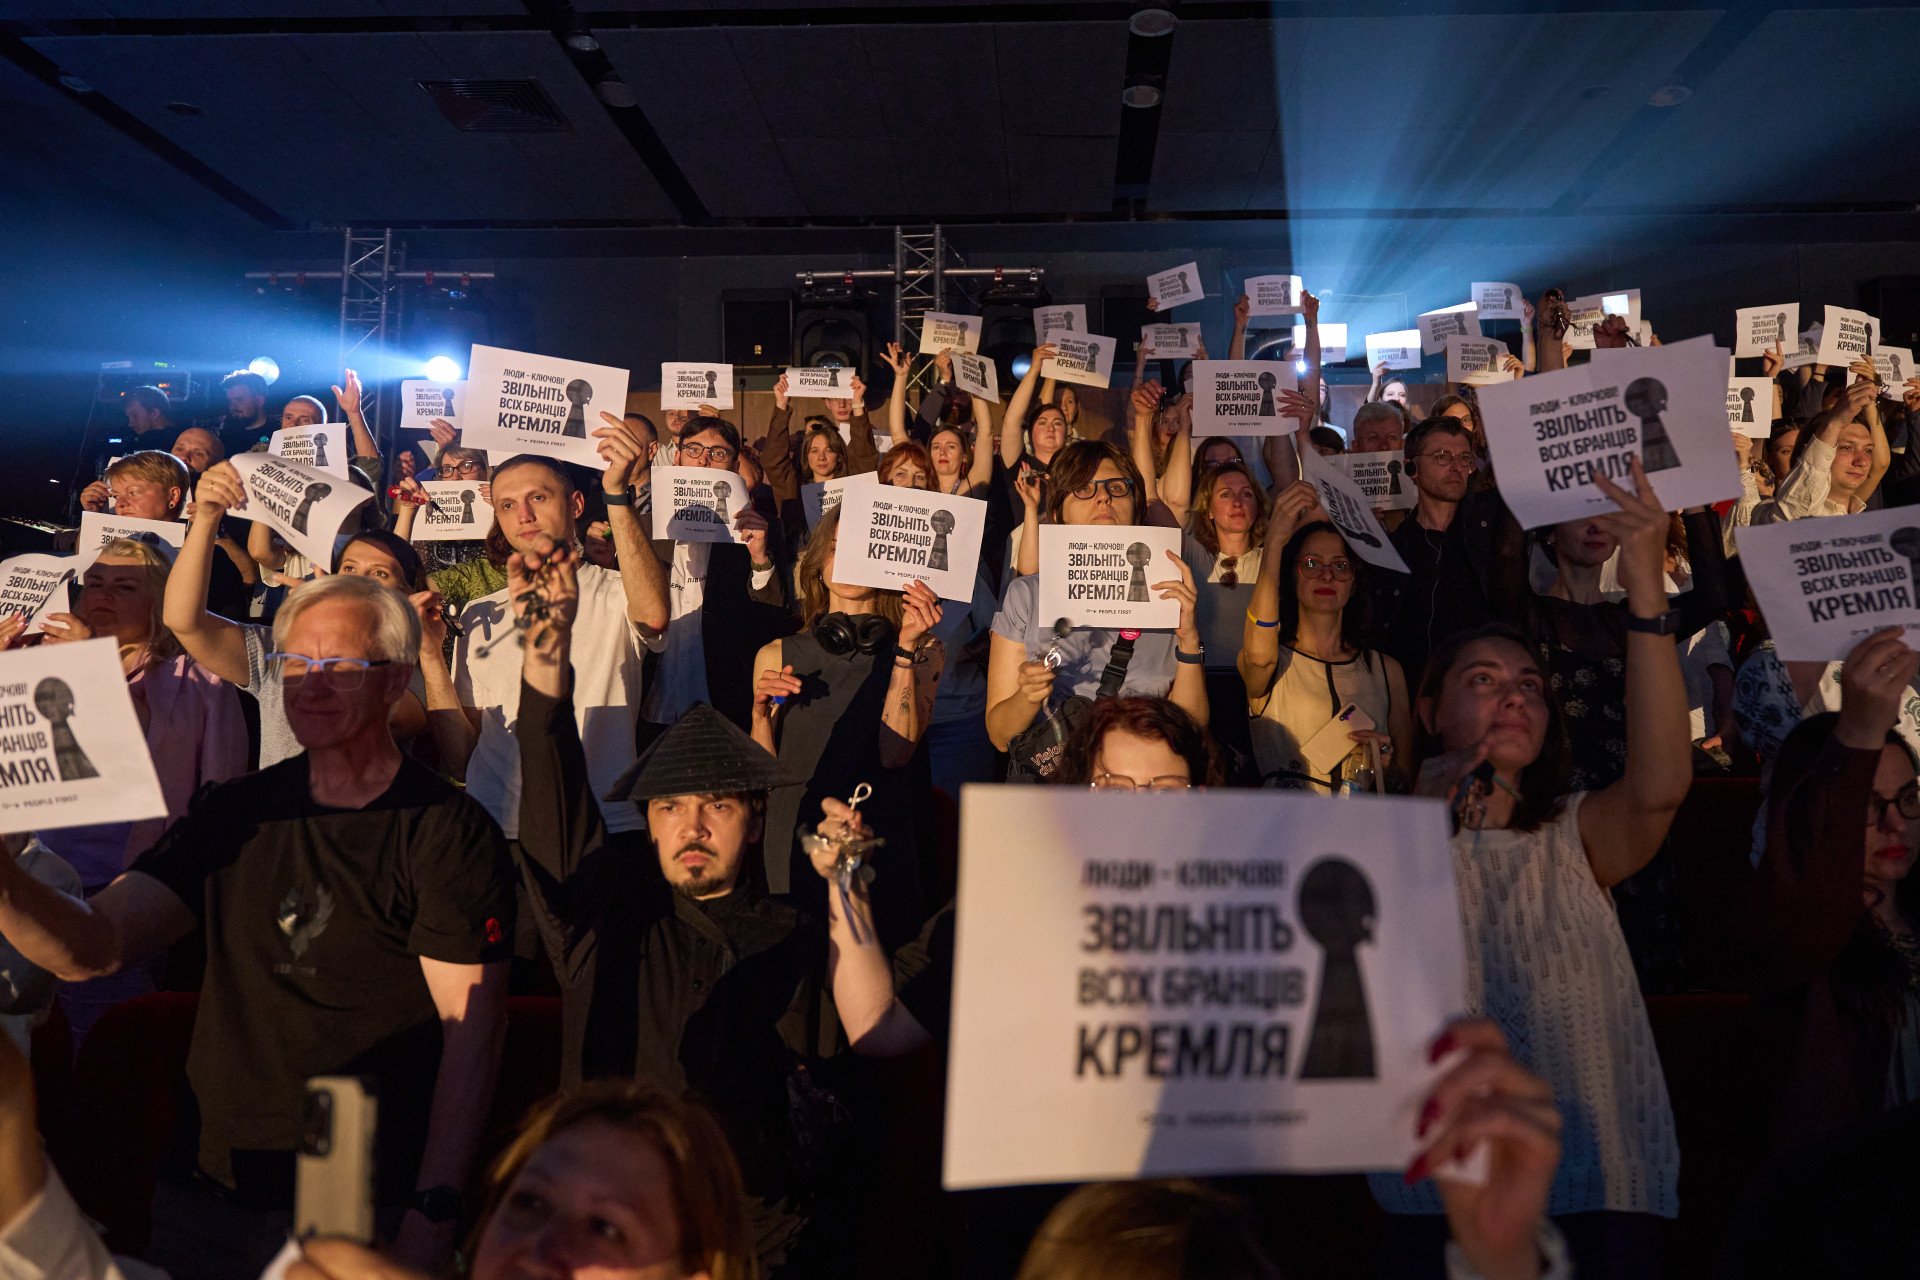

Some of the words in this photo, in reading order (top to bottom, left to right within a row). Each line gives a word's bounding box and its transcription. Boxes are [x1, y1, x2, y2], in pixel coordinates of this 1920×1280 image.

[1574, 328, 1592, 336] КРЕМ
[1840, 323, 1864, 335] ЗВІЛЬНІТЬ
[1752, 335, 1776, 344] КРЕМЛЯ
[1837, 341, 1865, 352] КРЕМЛЯ
[1060, 344, 1087, 354] ЗВІЛЬНІТЬ
[1057, 358, 1085, 370] КРЕМЛЯ
[1461, 363, 1487, 371] КРЕМЛЯ
[503, 369, 524, 378] ЛЮДИ
[532, 373, 565, 385] КЛЮЧОВІ!
[502, 380, 564, 402] ЗВІЛЬНІТЬ
[1216, 381, 1258, 390] ЗВІЛЬНІТЬ
[1216, 393, 1230, 401] ВСІХ
[1232, 393, 1260, 402] БРАНЦІВ
[1530, 399, 1560, 416] ЛЮДИ
[1569, 386, 1619, 406] КЛЮЧОВІ!
[500, 398, 522, 411] ВСІХ
[524, 402, 566, 417] БРАНЦІВ
[1216, 404, 1258, 416] КРЕМЛЯ
[498, 412, 561, 434] КРЕМЛЯ
[1534, 404, 1627, 441] ЗВІЛЬНІТЬ
[282, 440, 313, 449] ЗВІЛЬНІТЬ
[1538, 441, 1572, 463] ВСІХ
[1574, 427, 1638, 455] БРАНЦІВ
[256, 463, 304, 493] ЗВІЛЬНІТЬ
[1354, 468, 1387, 478] ЗВІЛЬНІТЬ
[250, 474, 267, 489] ВСІХ
[266, 481, 298, 507] БРАНЦІВ
[674, 487, 712, 498] ЗВІЛЬНІТЬ
[1361, 486, 1388, 496] РЕМЛЯ
[689, 500, 715, 508] БРАНЦІВ
[873, 501, 892, 510] ЛЮДИ
[899, 505, 930, 515] КЛЮЧОВІ!
[425, 515, 460, 524] КРЕМЛЯ
[674, 509, 711, 522] КРЕМЛЯ
[871, 512, 929, 532] ЗВІЛЬНІТЬ
[870, 528, 890, 540] ВСІХ
[892, 531, 931, 547] БРАНЦІВ
[868, 542, 926, 566] КРЕМЛЯ
[1068, 554, 1126, 567] ЗВІЛЬНІТЬ
[1794, 547, 1893, 576] ЗВІЛЬНІТЬ
[1068, 570, 1088, 580] ВСІХ
[1090, 570, 1128, 582] БРАНЦІВ
[1801, 575, 1839, 595] ВСІХ
[1839, 566, 1907, 587] БРАНЦІВ
[1, 589, 22, 600] ВСІХ
[22, 592, 46, 603] БРАН
[1068, 584, 1125, 600] КРЕМЛЯ
[1808, 586, 1911, 623] КРЕМЛЯ
[1030, 745, 1060, 766] Visio
[0, 757, 55, 788] МЛЯ
[1083, 860, 1154, 890] ЛЮДИ
[1082, 903, 1295, 954] ЗВІЛЬНІТЬ
[1077, 967, 1154, 1006] ВСІХ
[1162, 967, 1308, 1014] БРАНЦІВ
[1075, 1023, 1292, 1080] КРЕМЛЯ
